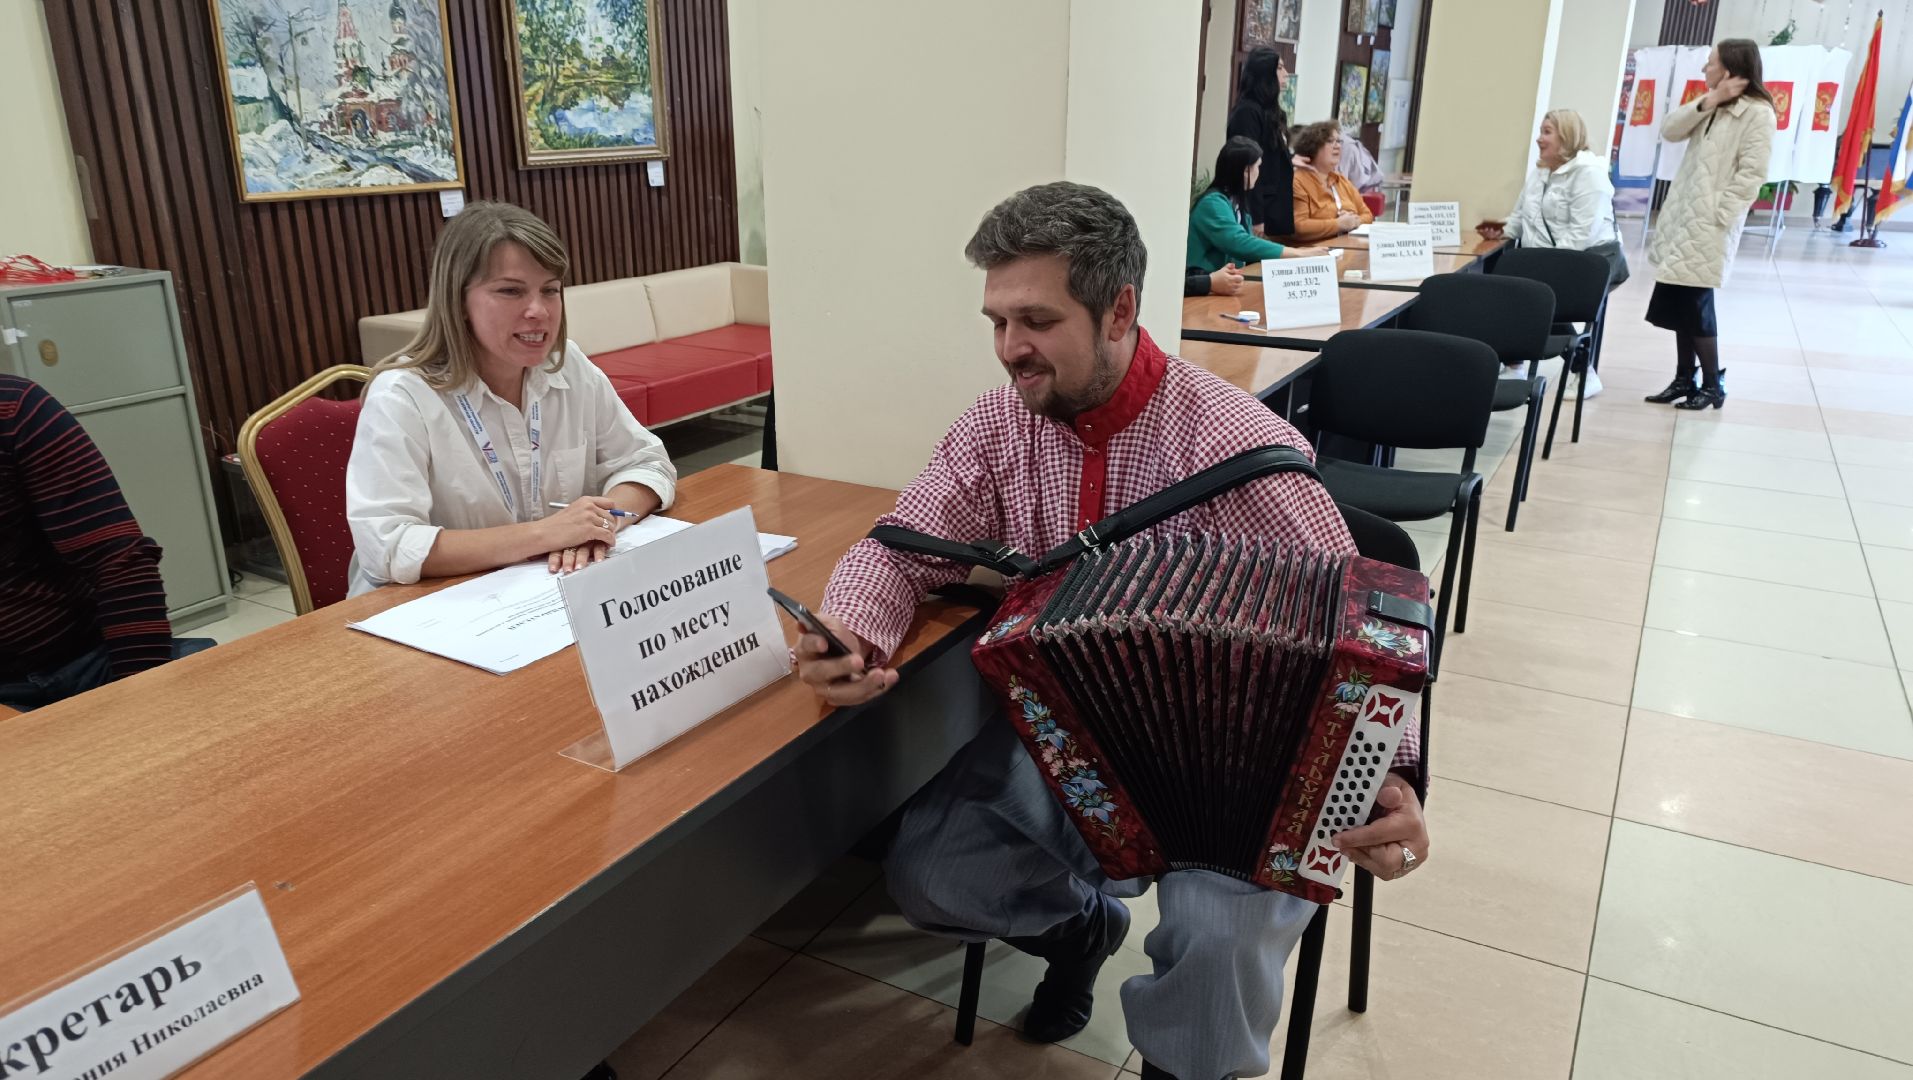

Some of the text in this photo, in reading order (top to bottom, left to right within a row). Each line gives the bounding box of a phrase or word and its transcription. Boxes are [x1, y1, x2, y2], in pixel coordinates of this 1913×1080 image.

[1271, 264, 1330, 278] улица ЛЕНИНА
[1396, 239, 1427, 248] МИРНАЯ
[1282, 280, 1303, 288] дома:
[599, 553, 743, 628] Голосование
[637, 600, 731, 660] по месту
[630, 631, 761, 712] нахождения
[130, 973, 265, 1057] Николаевна
